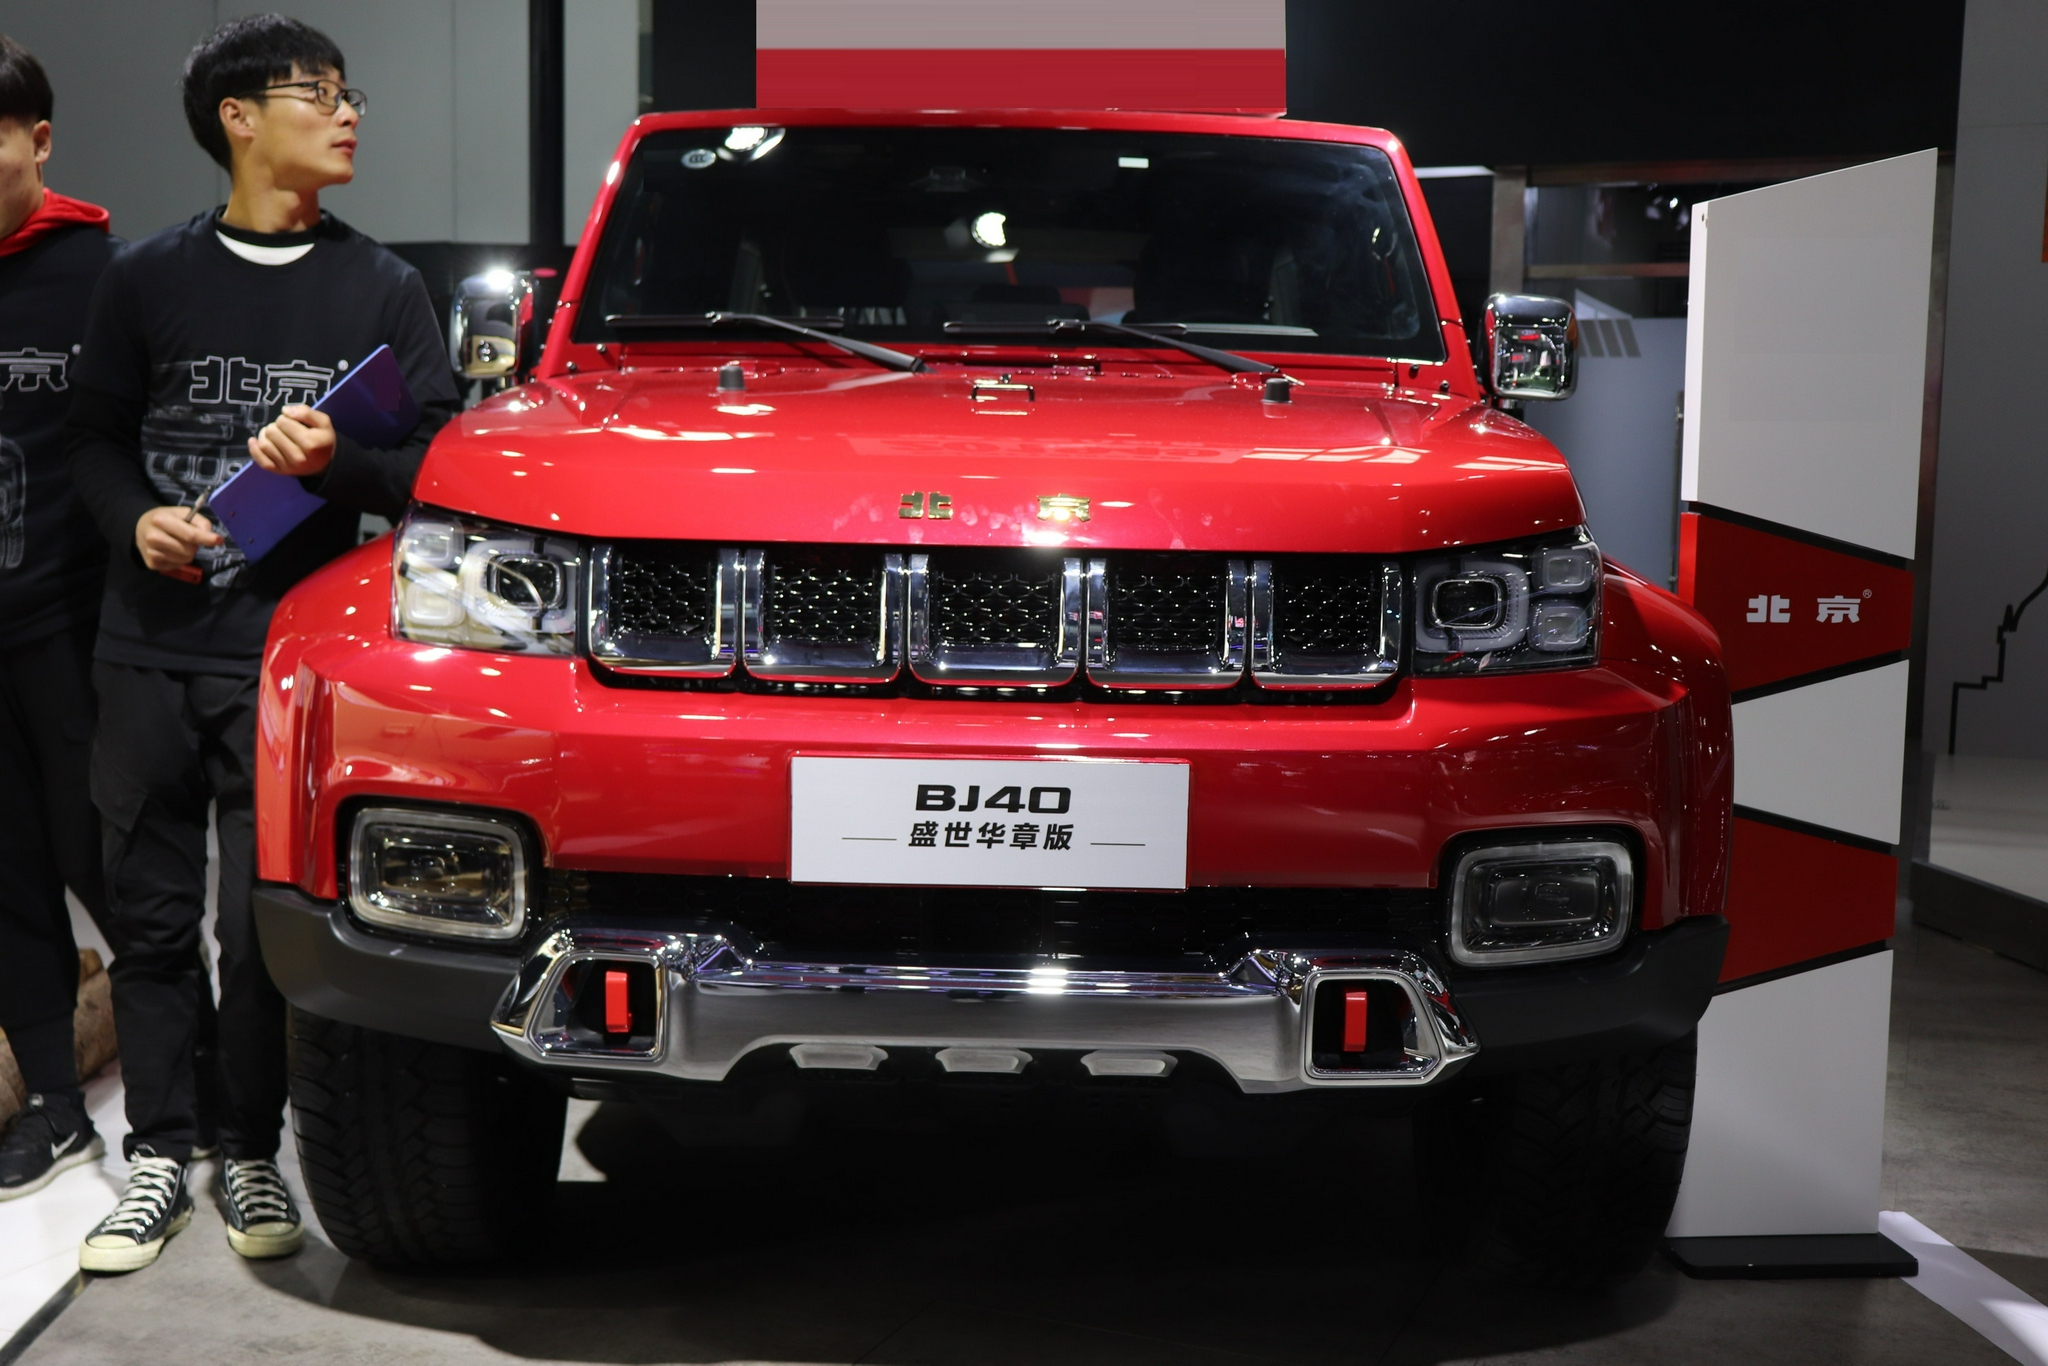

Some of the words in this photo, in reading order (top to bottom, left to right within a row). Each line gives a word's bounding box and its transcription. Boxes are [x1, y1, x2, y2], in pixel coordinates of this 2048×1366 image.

[189, 355, 335, 406] 北京
[899, 491, 1091, 521] 北京
[916, 784, 1072, 814] BJ40
[908, 820, 1074, 851] 盛世华章版
